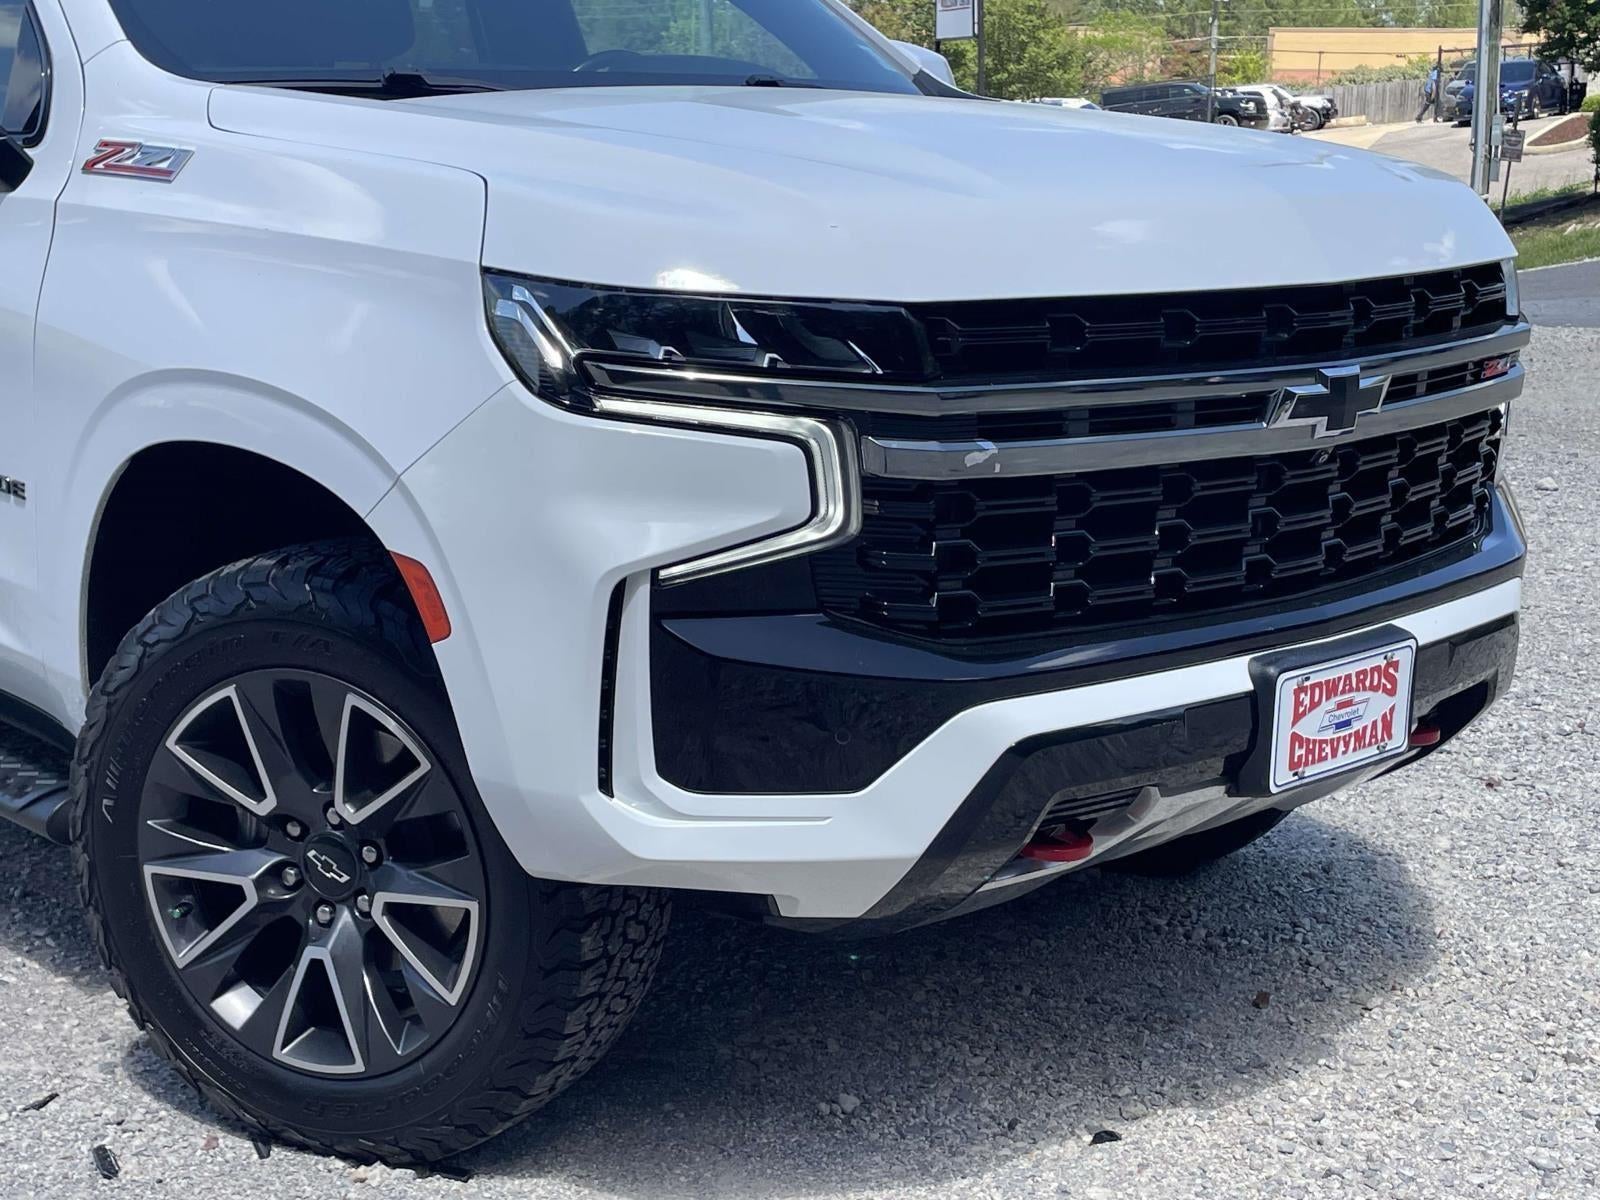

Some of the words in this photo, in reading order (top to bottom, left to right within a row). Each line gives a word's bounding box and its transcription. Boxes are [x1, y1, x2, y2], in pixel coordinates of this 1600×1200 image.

[81, 139, 195, 183] Z71
[1291, 659, 1400, 729] EDWARDS
[1328, 706, 1360, 724] Chevrolet
[1288, 702, 1396, 772] CHEVYMAN
